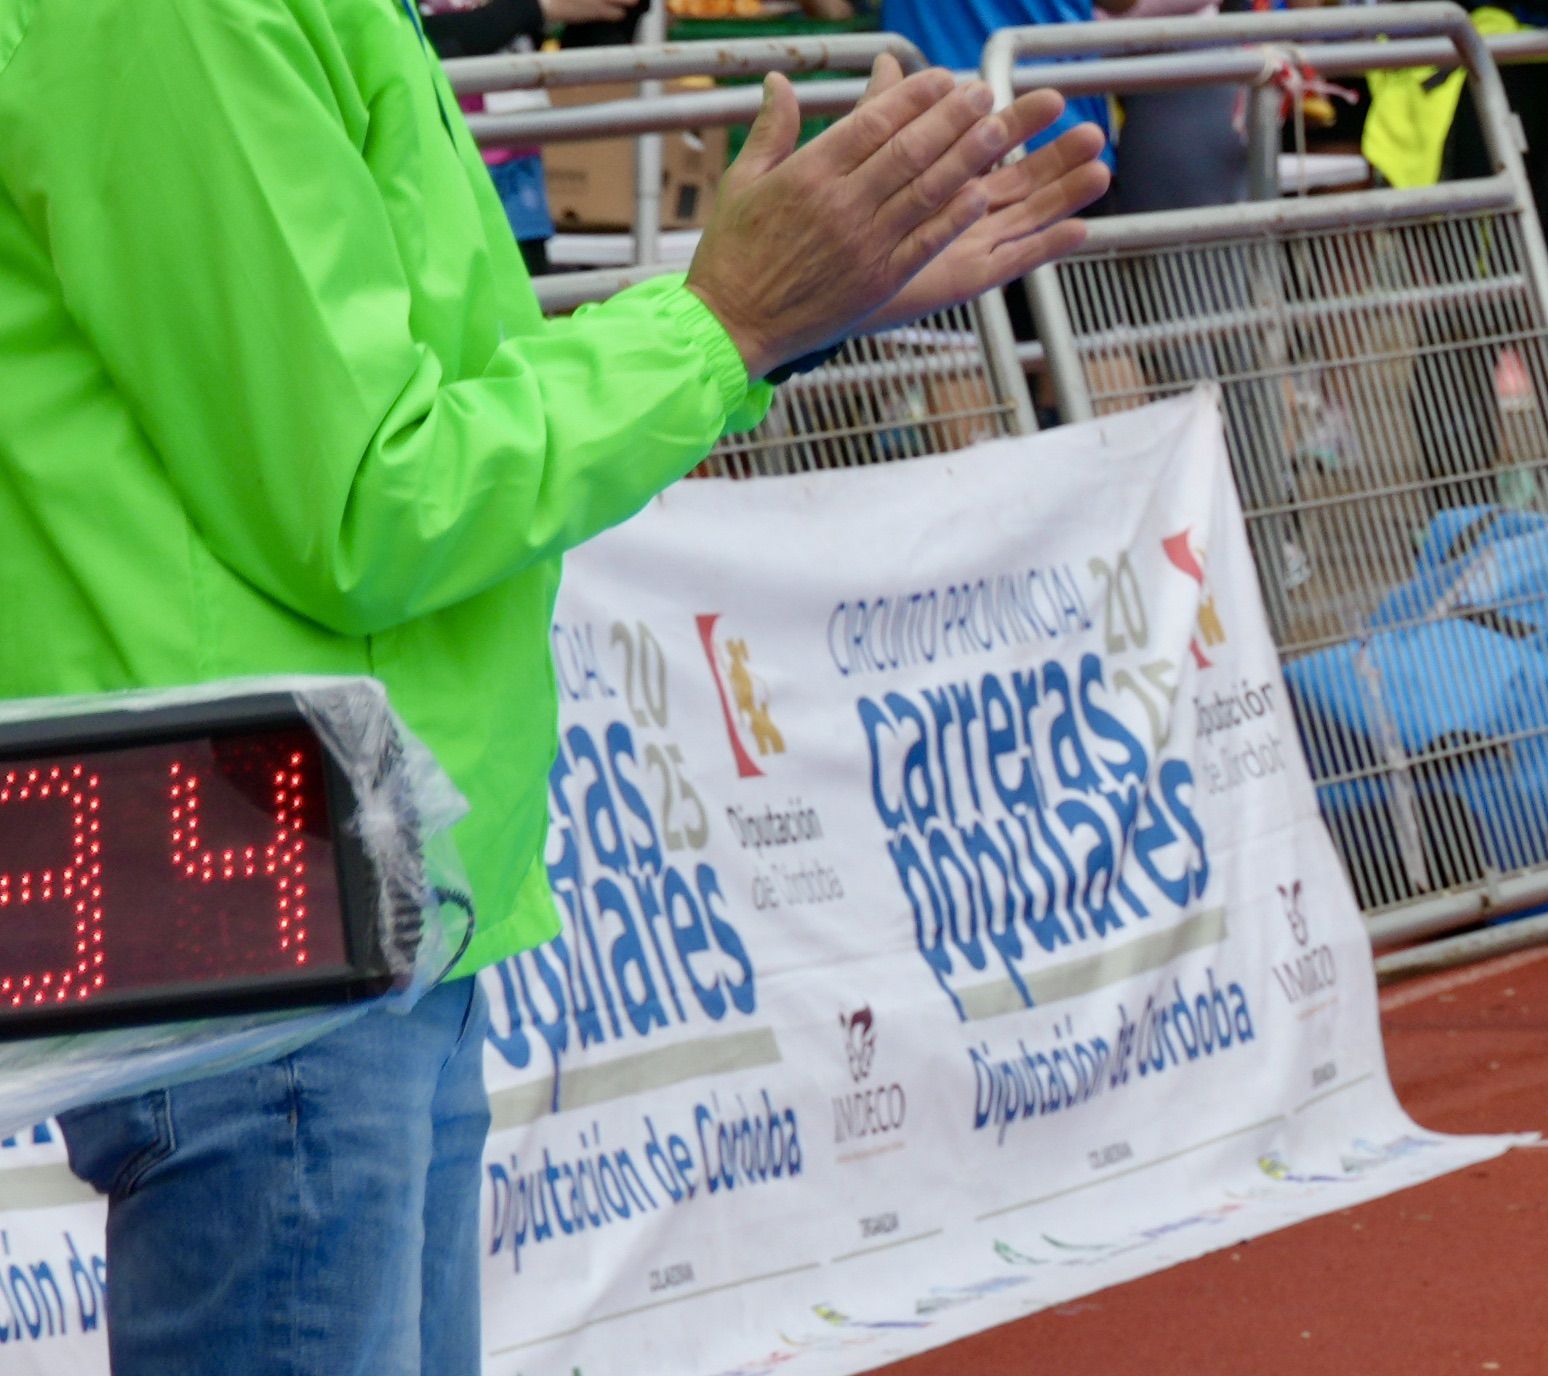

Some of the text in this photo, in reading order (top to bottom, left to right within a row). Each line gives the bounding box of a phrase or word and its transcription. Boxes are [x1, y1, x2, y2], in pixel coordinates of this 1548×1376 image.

[942, 563, 1092, 654] PROVINCIAL
[1087, 550, 1149, 655] 20
[610, 620, 668, 729] 20
[645, 742, 710, 852] 25
[857, 652, 1149, 839] carreras
[887, 758, 1210, 1023] populares
[968, 1016, 1110, 1148] Diputación
[1137, 967, 1255, 1077] Córdoba
[487, 1120, 659, 1275] Diputación
[643, 1115, 698, 1204] de
